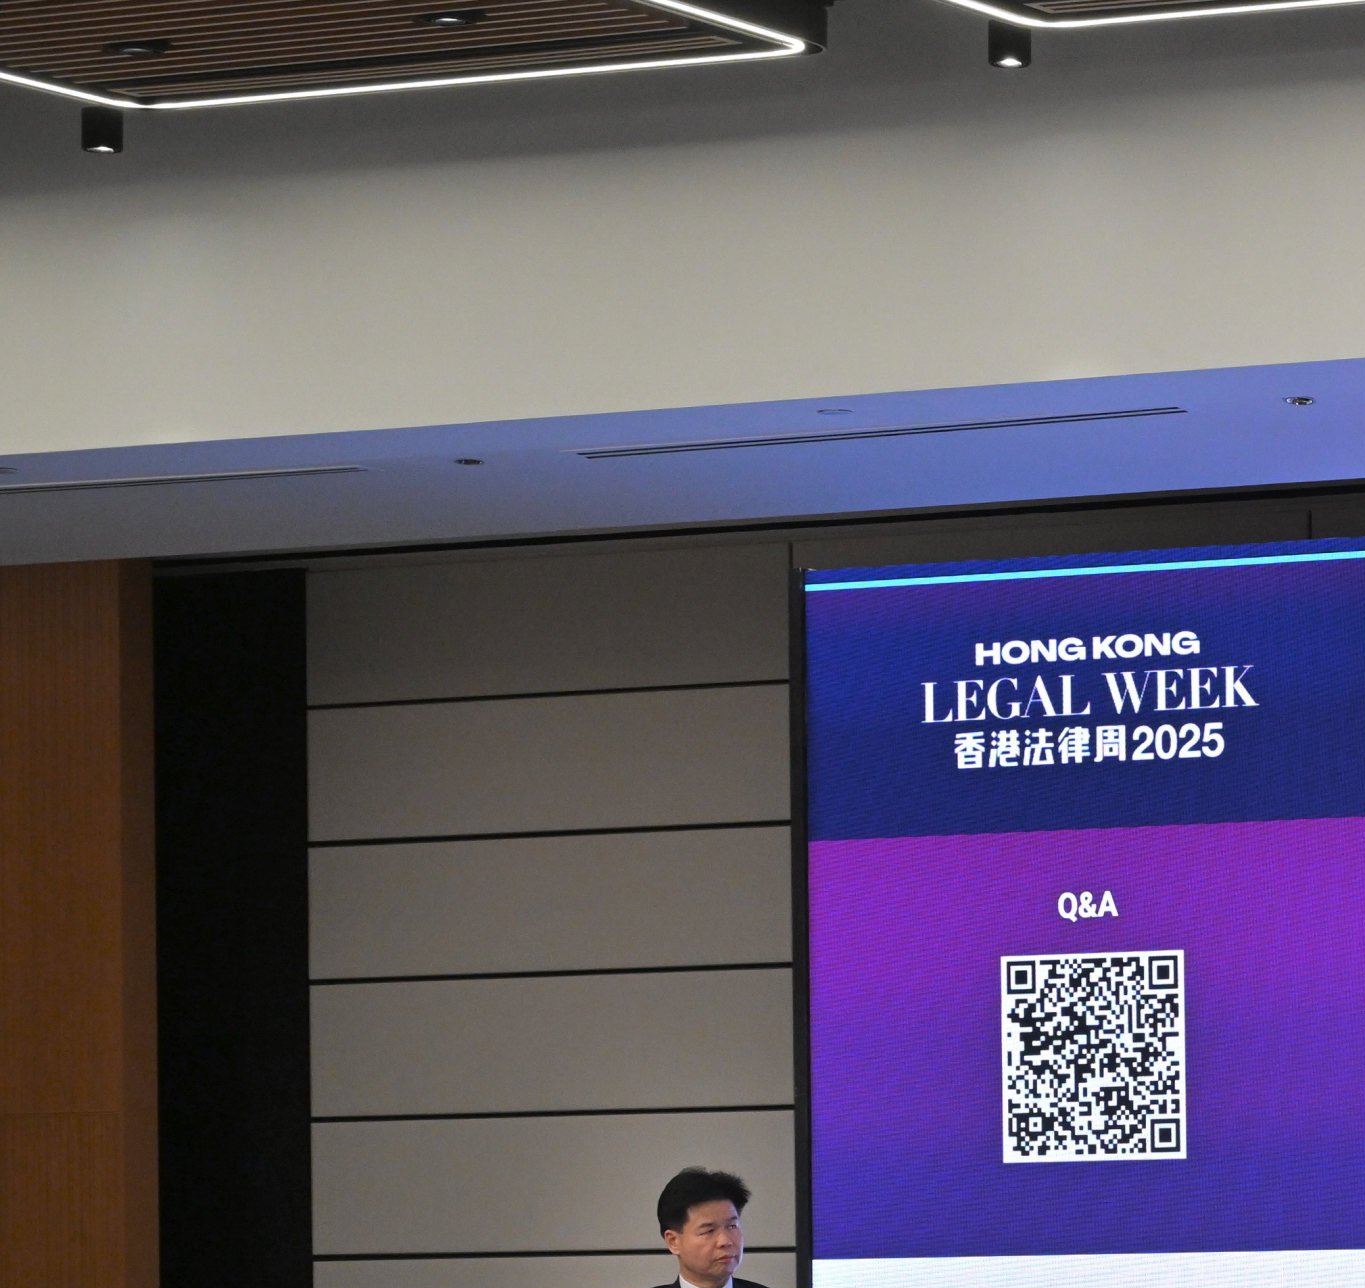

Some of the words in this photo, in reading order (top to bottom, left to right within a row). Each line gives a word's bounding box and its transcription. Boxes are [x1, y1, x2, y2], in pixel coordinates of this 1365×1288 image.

[975, 637, 1086, 666] HONG
[1092, 631, 1200, 659] KONG
[921, 675, 1090, 723] LEGAL
[1102, 665, 1259, 714] WEEK
[954, 722, 1225, 769] 香港法律周2025
[1058, 890, 1119, 922] Q&A
